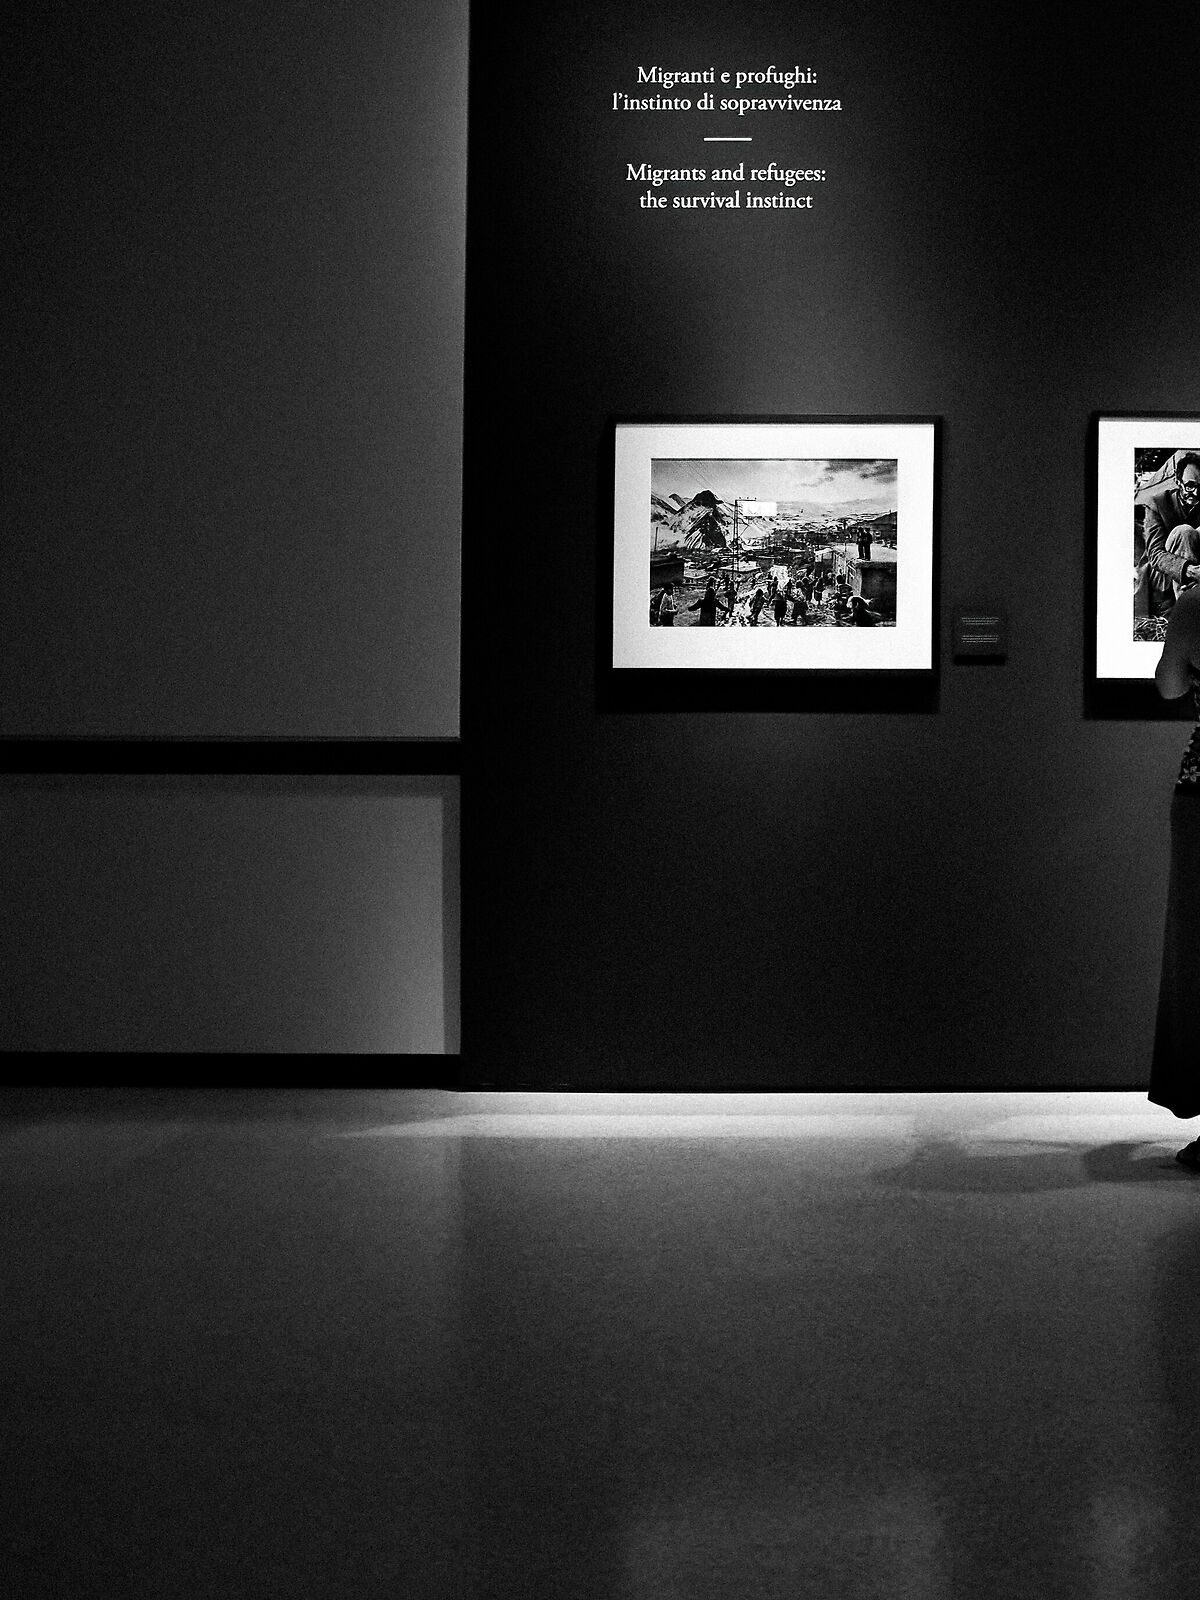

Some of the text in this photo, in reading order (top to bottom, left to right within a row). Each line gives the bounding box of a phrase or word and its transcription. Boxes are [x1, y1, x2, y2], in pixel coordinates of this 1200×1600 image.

[637, 65, 817, 89] Migranti e profughi:
[612, 92, 842, 115] l’instinto di sopravvivenza
[626, 162, 826, 186] Migrants and refugees:
[639, 190, 813, 209] the survival instinct
